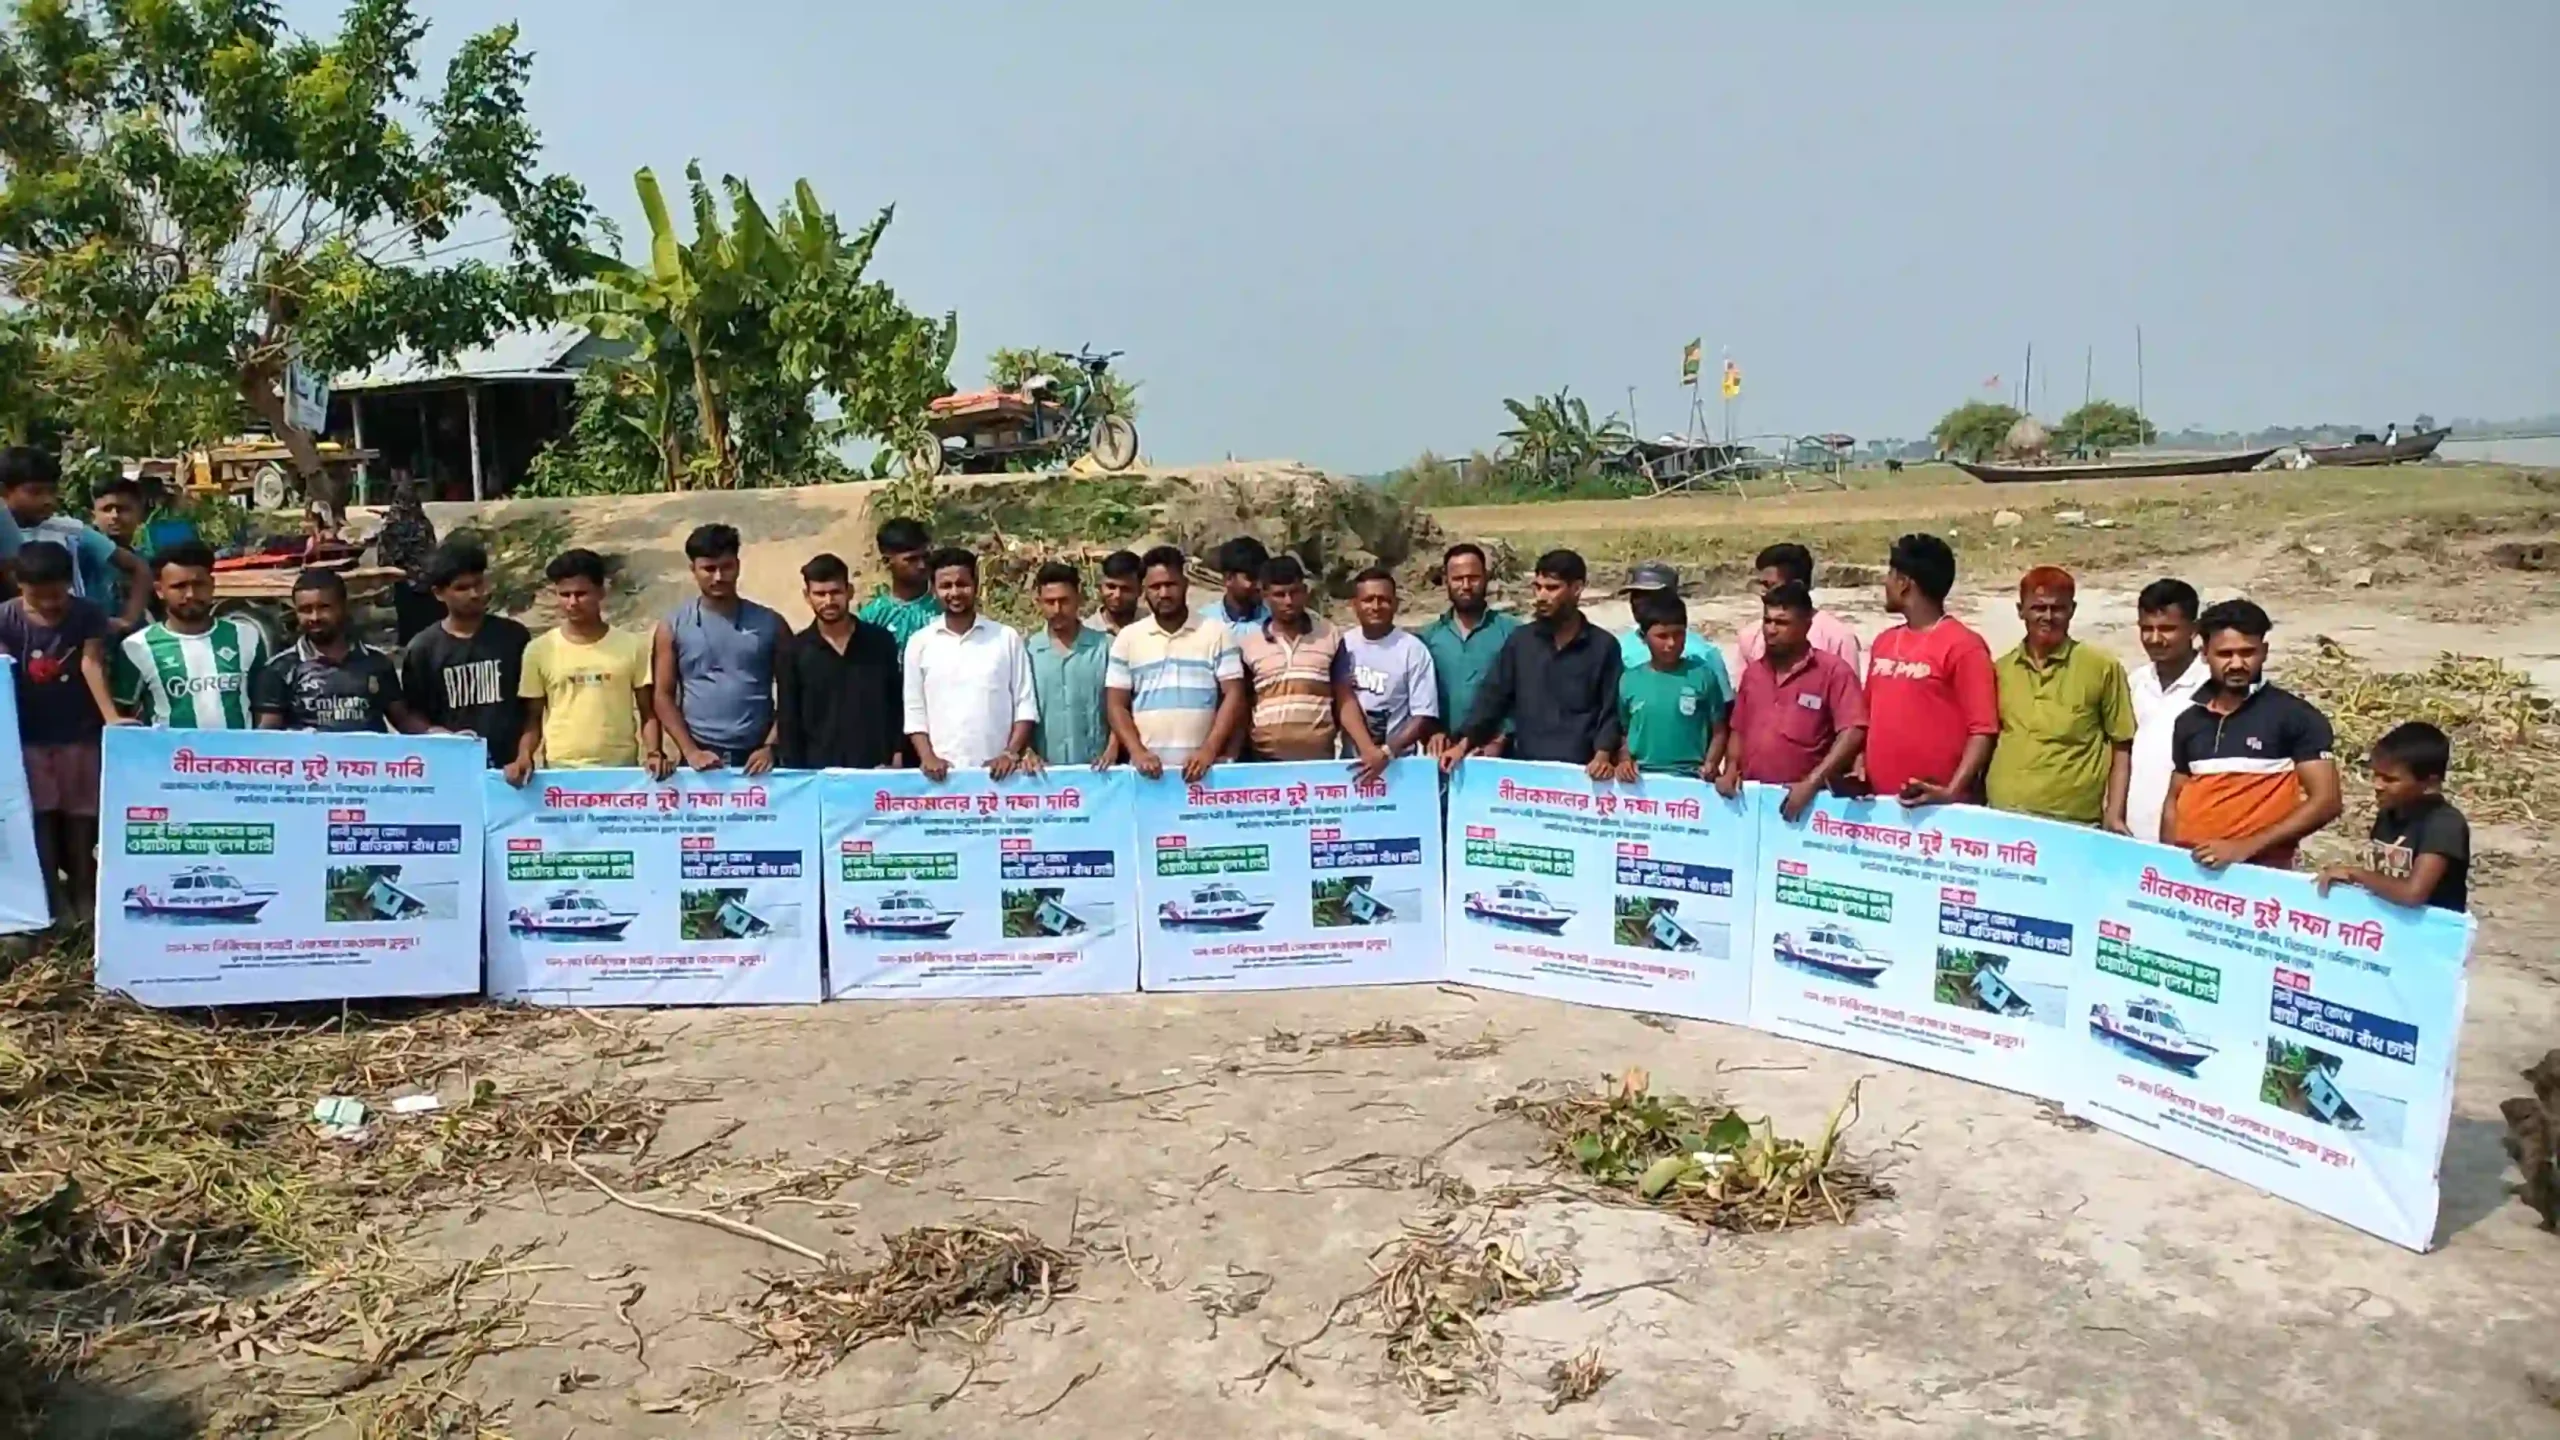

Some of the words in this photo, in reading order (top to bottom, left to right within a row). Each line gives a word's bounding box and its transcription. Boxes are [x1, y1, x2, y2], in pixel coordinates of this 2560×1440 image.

[302, 754, 328, 780] দুই
[337, 758, 378, 777] দফা
[387, 755, 424, 777] দাবি
[655, 787, 679, 811] দুই
[687, 789, 724, 808] দফা
[731, 785, 766, 807] দাবি
[976, 790, 998, 814] দুই
[1005, 792, 1040, 810] দফা
[1047, 787, 1080, 809] দাবি
[1286, 782, 1308, 805] দুই
[1314, 782, 1348, 801] দফা
[1596, 791, 1617, 816] দুই
[1624, 796, 1658, 816] দফা
[1666, 797, 1699, 820] দাবি
[437, 838, 459, 851] চাই
[1918, 828, 1942, 857] দুই
[1950, 835, 1990, 860] দফা
[1998, 837, 2037, 866] দাবি
[2252, 895, 2280, 932] দুই
[2287, 907, 2331, 940] দফা
[2339, 915, 2384, 953] দাবি
[2386, 1036, 2414, 1061] চাই
